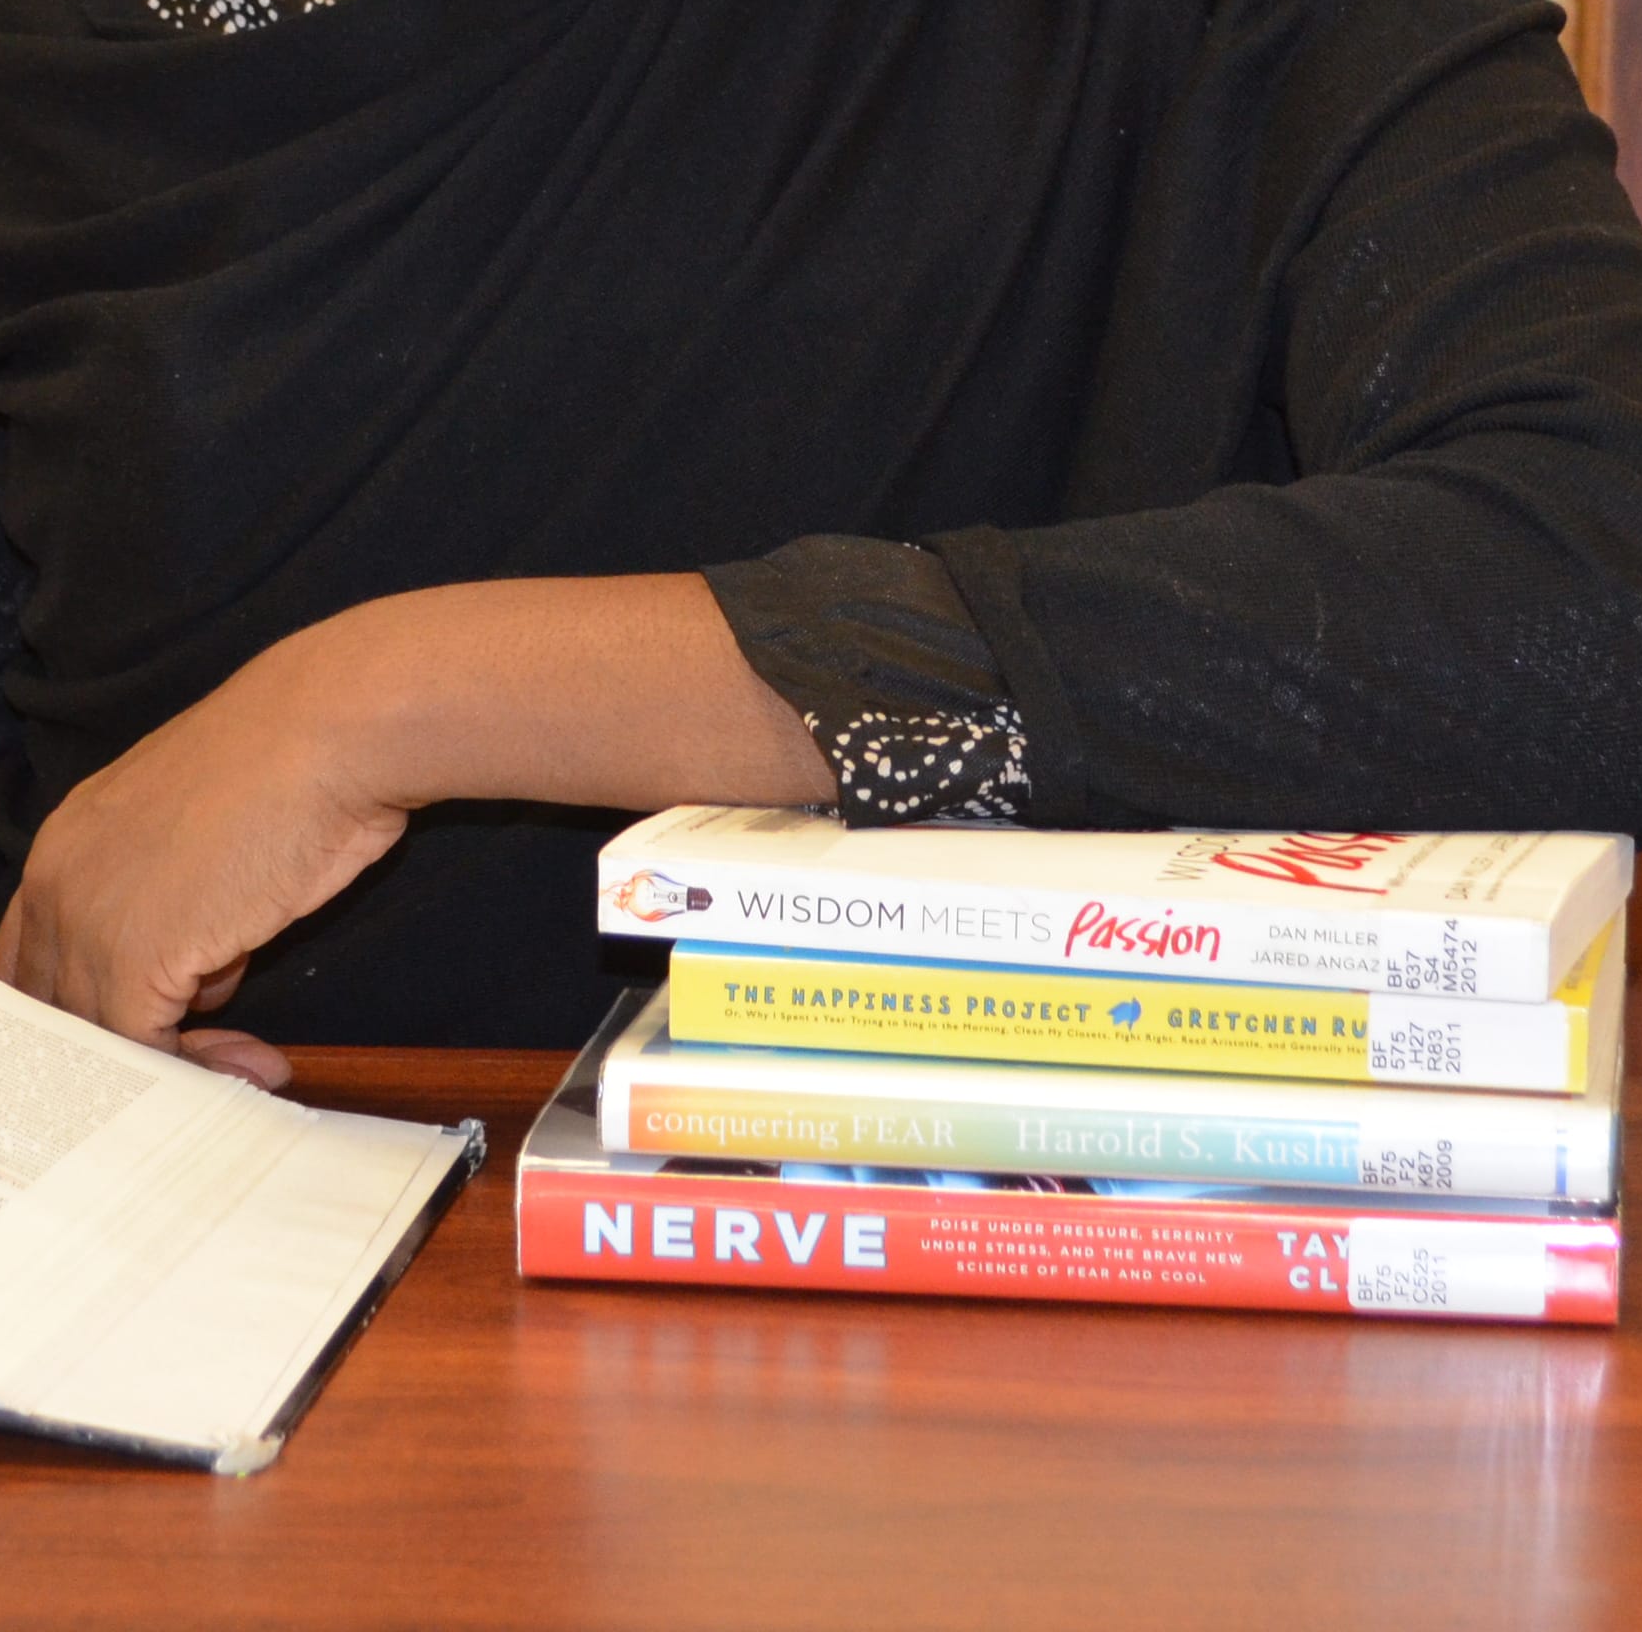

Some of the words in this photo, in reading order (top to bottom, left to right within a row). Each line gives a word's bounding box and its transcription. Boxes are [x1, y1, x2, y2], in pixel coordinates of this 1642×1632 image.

[737, 890, 905, 931] WISDOM
[921, 904, 1052, 943] MEETS
[1064, 901, 1221, 962] Passion
[1268, 925, 1308, 942] DAN
[1312, 929, 1379, 947] MILLER
[1250, 950, 1310, 968] JARED
[1386, 957, 1402, 988] BF
[1405, 950, 1421, 990] 637
[1442, 918, 1459, 993] M5474
[1460, 940, 1477, 995] 2012
[724, 982, 776, 1005] THE
[791, 987, 951, 1016] HAPPINESS
[966, 995, 1092, 1023] PROJECT
[1167, 1007, 1318, 1036] GRETCHEN
[1332, 1016, 1368, 1039] RU
[746, 1010, 770, 1022] Why
[780, 1012, 810, 1024] Spent
[823, 1014, 846, 1025] Year
[851, 1016, 884, 1028] Trying
[888, 1019, 899, 1028] to
[903, 1019, 925, 1031] Sing
[928, 1021, 938, 1030] in
[942, 1022, 958, 1032] the
[1013, 1025, 1044, 1036] Clean
[1047, 1027, 1063, 1039] My
[1114, 1032, 1142, 1044] Fight
[1181, 1034, 1207, 1046] Read
[1267, 1041, 1287, 1051] and
[1290, 1042, 1342, 1055] Generally
[1390, 1030, 1406, 1071] 575
[1427, 1029, 1443, 1072] R83
[1445, 1023, 1462, 1074] 2011
[1372, 1039, 1388, 1069] BF
[645, 1108, 841, 1152] conquering
[851, 1114, 957, 1149] FEAR
[1014, 1117, 1163, 1161] Harold
[1178, 1122, 1216, 1163] S.
[1362, 1159, 1378, 1185] BF
[1381, 1151, 1397, 1186] 575
[1418, 1150, 1434, 1188] K87
[1437, 1139, 1453, 1189] 2009
[582, 1200, 889, 1269] NERVE
[930, 1218, 980, 1233] POISE
[988, 1220, 1045, 1235] UNDER
[1151, 1227, 1236, 1244] SERENITY
[1276, 1231, 1350, 1259] TAY
[920, 1238, 978, 1253] UNDER
[1060, 1244, 1096, 1259] AND
[1103, 1247, 1135, 1261] THE
[1142, 1249, 1198, 1264] BRAVE
[1205, 1252, 1245, 1266] NEW
[955, 1260, 1029, 1276] SCIENCE
[1036, 1263, 1059, 1277] OF
[1066, 1265, 1111, 1280] FEAR
[1118, 1267, 1153, 1282] AND
[1160, 1270, 1207, 1285] COOL
[1358, 1272, 1374, 1302] BF
[1376, 1264, 1392, 1303] 575
[1412, 1248, 1429, 1304] C525
[1431, 1256, 1447, 1305] 2011
